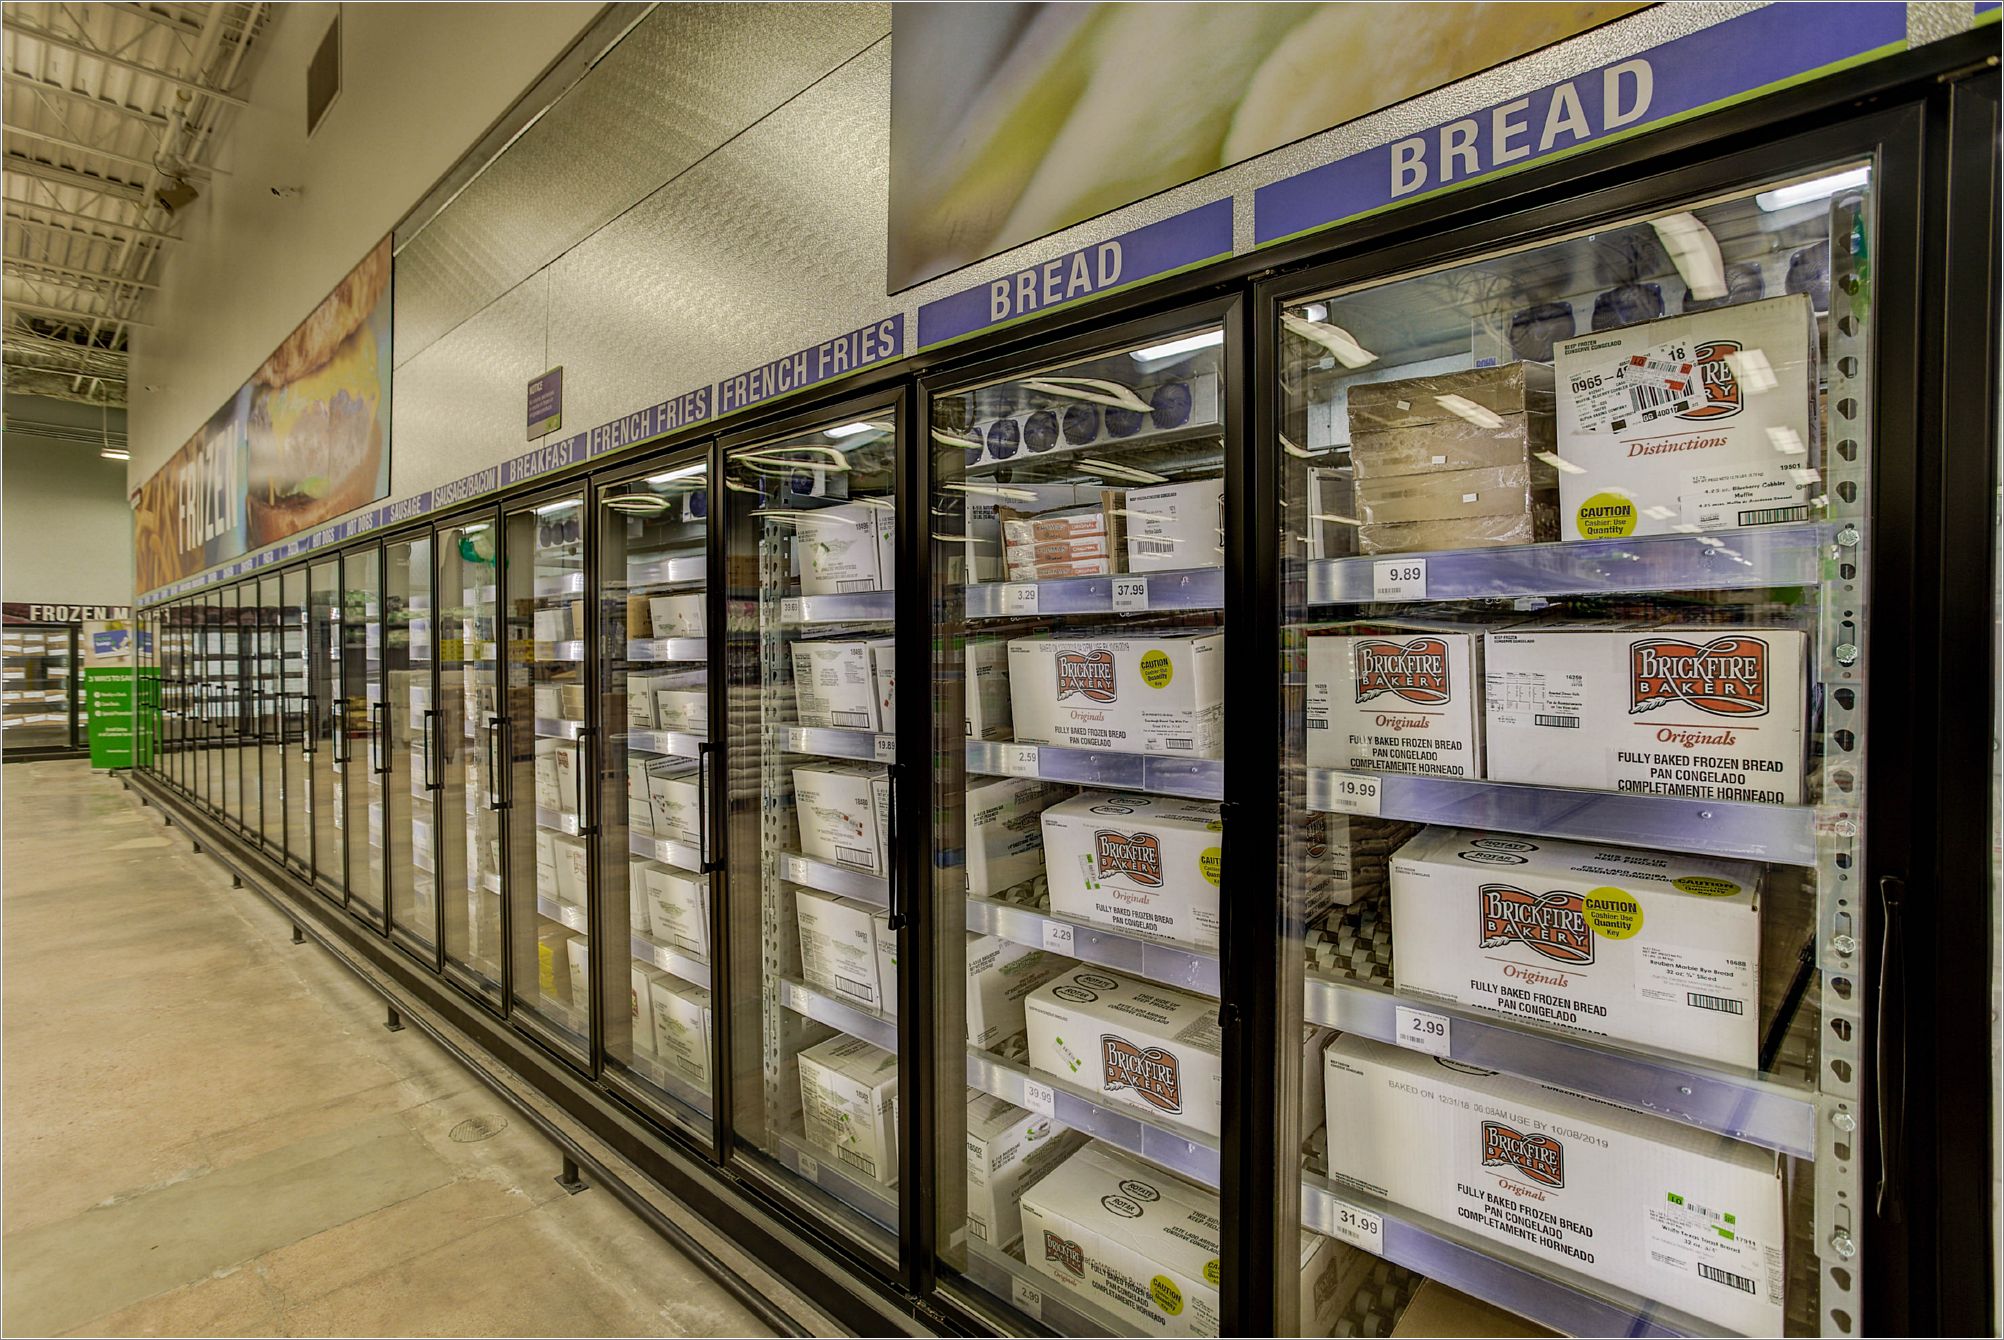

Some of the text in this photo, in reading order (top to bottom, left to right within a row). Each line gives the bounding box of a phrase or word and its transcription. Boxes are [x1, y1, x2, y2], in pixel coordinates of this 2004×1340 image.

[1391, 58, 1654, 199] BREAD
[990, 241, 1122, 322] BREAD
[1668, 347, 1686, 361] 18
[723, 319, 896, 412] FRENCH FRIES
[593, 389, 707, 455] FRENCH FRIES
[1627, 435, 1728, 458] Distinctions
[509, 438, 575, 483] BREAKFAST
[179, 419, 239, 555] FROZEN
[435, 468, 496, 508] SAUSAGE/BACON
[390, 496, 421, 522] SAUSAGE
[1580, 505, 1631, 518] CAUTION
[346, 512, 373, 536] HOT DOGS
[1587, 526, 1624, 536] Quantity
[1389, 568, 1421, 581] 9.89
[1018, 590, 1035, 600] 3.29
[1117, 584, 1144, 596] 37.99
[30, 604, 107, 622] FROZEN
[1140, 658, 1169, 669] CAUTION
[1061, 680, 1112, 688] BAKERY
[1362, 676, 1443, 687] BAKERY
[1640, 682, 1757, 695] BAKERY
[1070, 710, 1104, 723] Originals
[1376, 714, 1430, 731] Originals
[1055, 726, 1126, 738] FULLY BAKED FROZEN BREAD
[1656, 728, 1736, 748] Originals
[878, 741, 895, 750] 19.89
[1069, 736, 1111, 747] PAN CONGELADO
[1349, 735, 1462, 750] FULLY BAKED FROZEN BREAD
[1019, 752, 1036, 762] 2.59
[1372, 748, 1438, 761] PAN CONGELADO
[1618, 752, 1783, 772] FULLY BAKED FROZEN BREAD
[1350, 758, 1464, 776] COMPLETAMENTE HORNEADO
[1650, 768, 1745, 785] PAN CONGELADO
[1338, 781, 1376, 797] 19.99
[1618, 779, 1785, 804] COMPLETAMENTE HORNEADO
[1485, 840, 1526, 848] ROTATE
[1475, 852, 1512, 861] ROTAR
[1101, 858, 1159, 873] BAKERY
[1678, 878, 1734, 889] CAUTION
[1112, 889, 1150, 905] Originals
[1095, 903, 1174, 925] FULLY BAKED FROZEN BREAD
[1585, 898, 1637, 914] CAUTION
[1112, 916, 1158, 932] PAN CONGELADO
[1591, 912, 1634, 922] Cashier: Use
[1594, 918, 1632, 931] Quantity
[1052, 928, 1072, 941] 2.29
[1488, 921, 1586, 947] BAKERY
[1606, 928, 1620, 937] Key
[1503, 964, 1568, 988] Originals
[1471, 979, 1607, 1017] FULLY BAKED FROZEN BREAD
[1498, 997, 1516, 1009] PAN
[1518, 1001, 1577, 1023] CONGELADO
[1413, 1018, 1445, 1036] 2.99
[1108, 1067, 1176, 1098] BAKERY
[1028, 1086, 1052, 1104] 39.99
[1388, 1080, 1418, 1095] BAKED
[1421, 1088, 1434, 1100] ON
[1509, 1113, 1531, 1127] USE
[1534, 1120, 1548, 1131] BY
[1551, 1125, 1609, 1149] 10/08/2019
[1488, 1147, 1558, 1175] BAKERY
[1128, 1183, 1155, 1198] ROTATE
[1498, 1178, 1547, 1202] Originals
[1112, 1198, 1135, 1213] ROTAR
[1457, 1183, 1593, 1239] FULLY BAKED FROZEN BREAD
[1340, 1209, 1378, 1235] 31.99
[1484, 1205, 1563, 1240] PAN CONGELADO
[1457, 1206, 1595, 1264] COMPLETAMENTE HORNEADO
[1021, 1287, 1040, 1304] 2.99
[1105, 1279, 1117, 1291] PAN
[1117, 1286, 1149, 1307] CONGELADO
[1153, 1278, 1181, 1303] CAUTION
[1091, 1280, 1136, 1310] COMPLETAMENTE
[1136, 1301, 1166, 1326] HORNEADO
